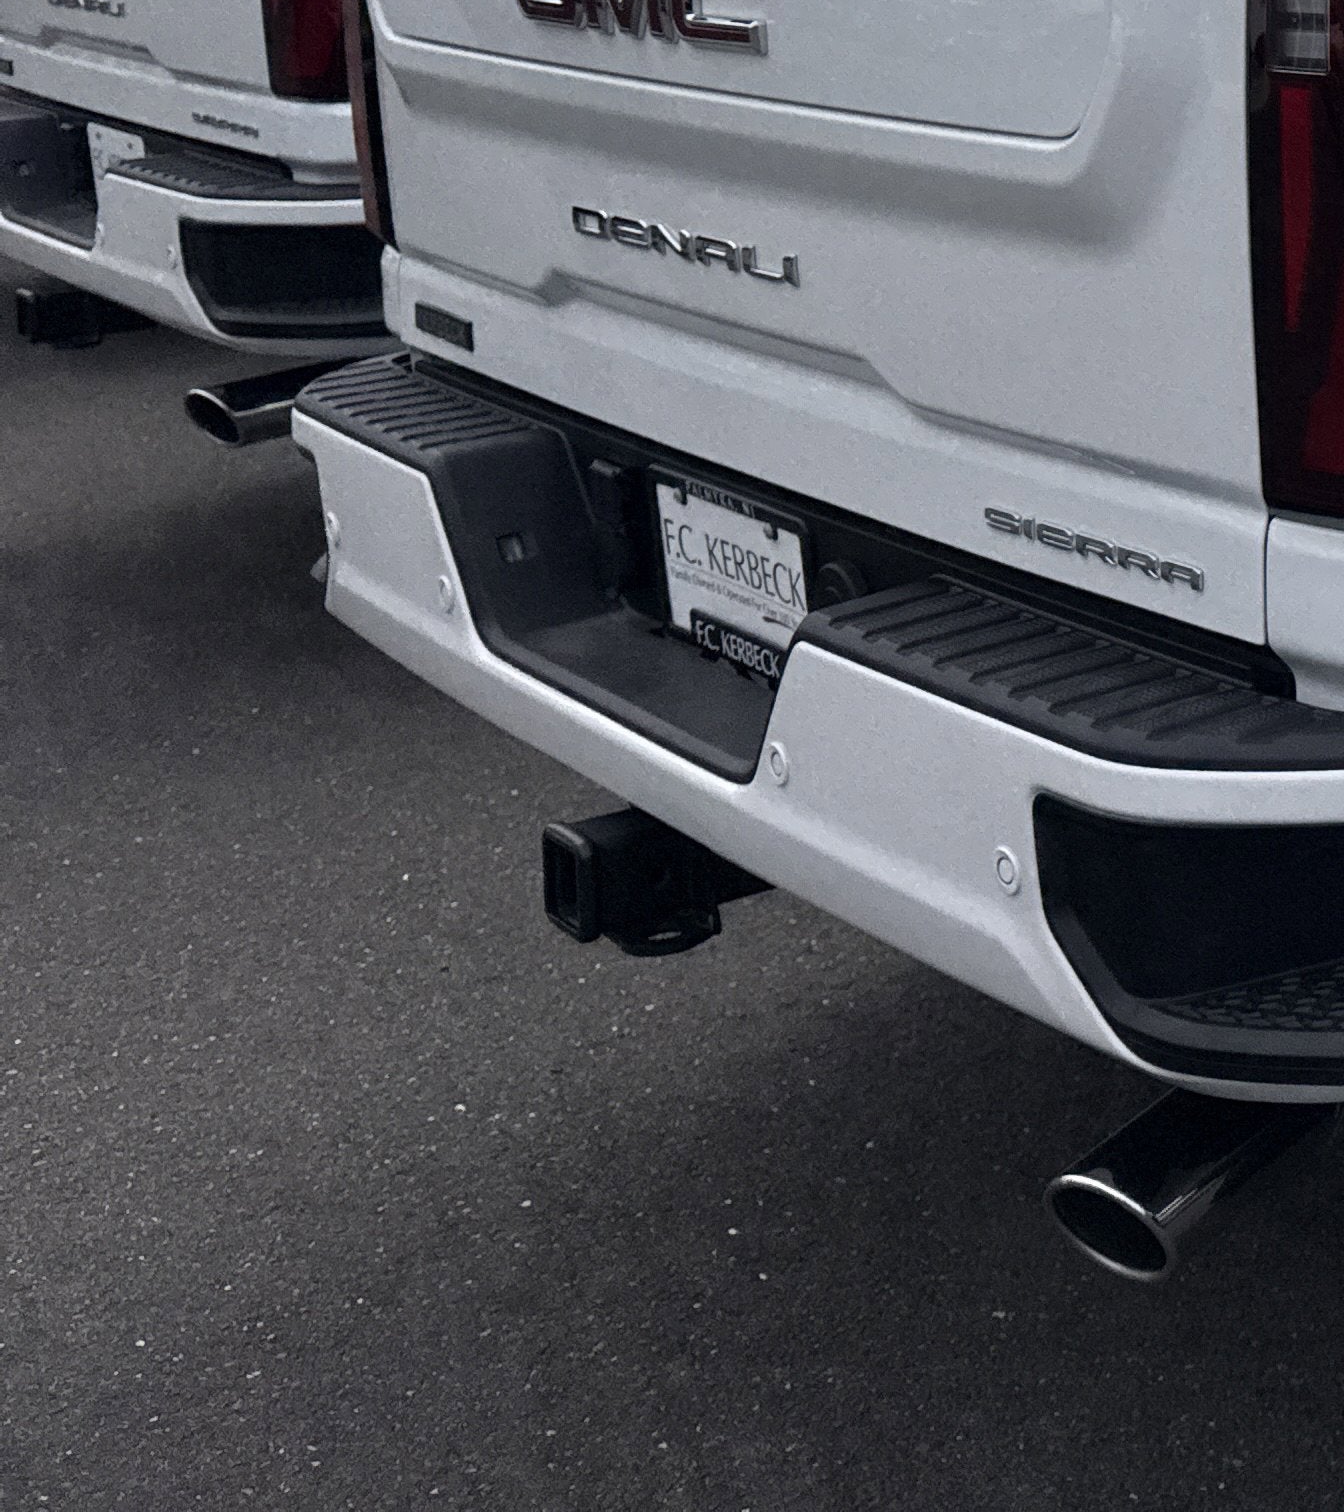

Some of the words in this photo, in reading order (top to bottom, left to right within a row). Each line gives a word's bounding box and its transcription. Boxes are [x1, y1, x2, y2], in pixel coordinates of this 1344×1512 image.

[572, 205, 800, 288] DENALI
[663, 518, 702, 566] F.C.
[704, 533, 808, 612] KERBECK
[984, 507, 1204, 592] SIERRA
[720, 630, 780, 678] KERBECK
